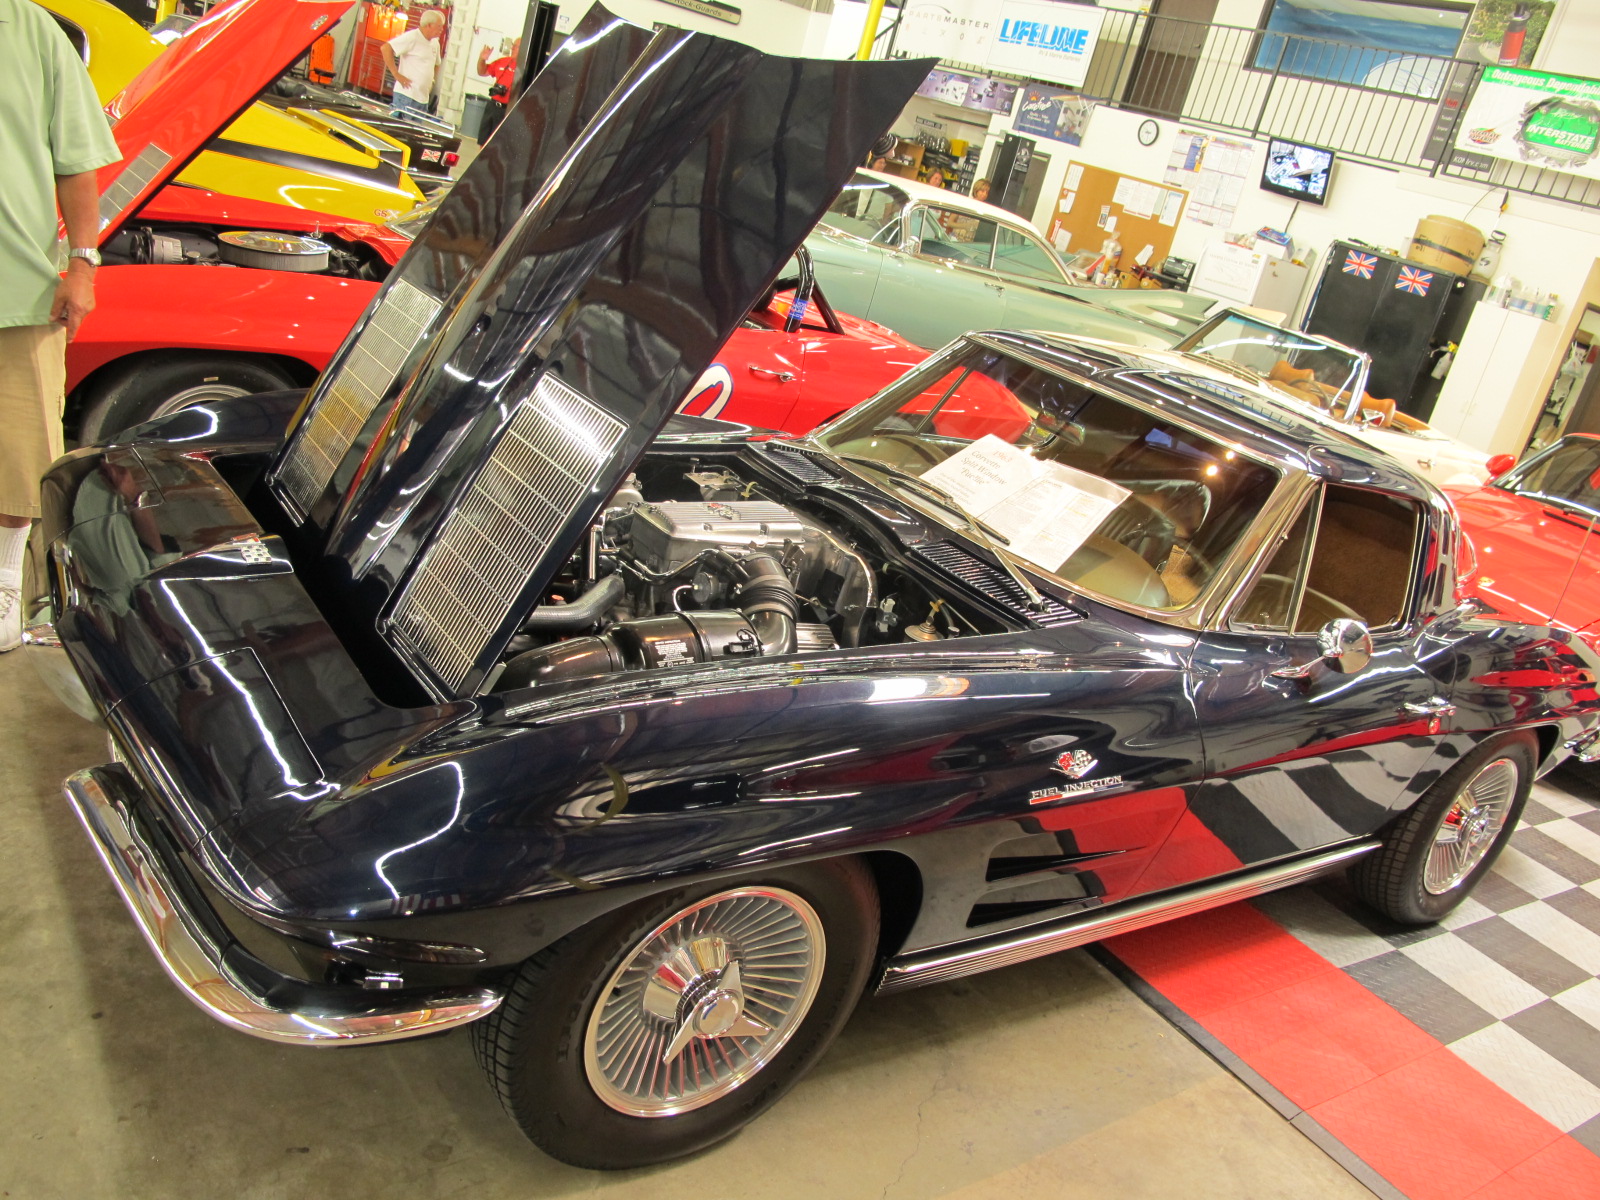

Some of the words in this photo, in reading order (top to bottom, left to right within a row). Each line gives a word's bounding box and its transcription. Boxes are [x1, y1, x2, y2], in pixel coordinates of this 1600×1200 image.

[999, 18, 1089, 54] LIFELINE
[1491, 69, 1546, 86] Outrageous
[1526, 124, 1595, 145] INTERSTATE
[1554, 138, 1593, 151] BATTERIES
[373, 208, 401, 219] GSX
[971, 450, 1001, 469] Corvette
[961, 457, 979, 469] Split
[977, 464, 1007, 485] Window
[1030, 786, 1060, 799] FUEL
[1064, 775, 1122, 792] INJECTION
